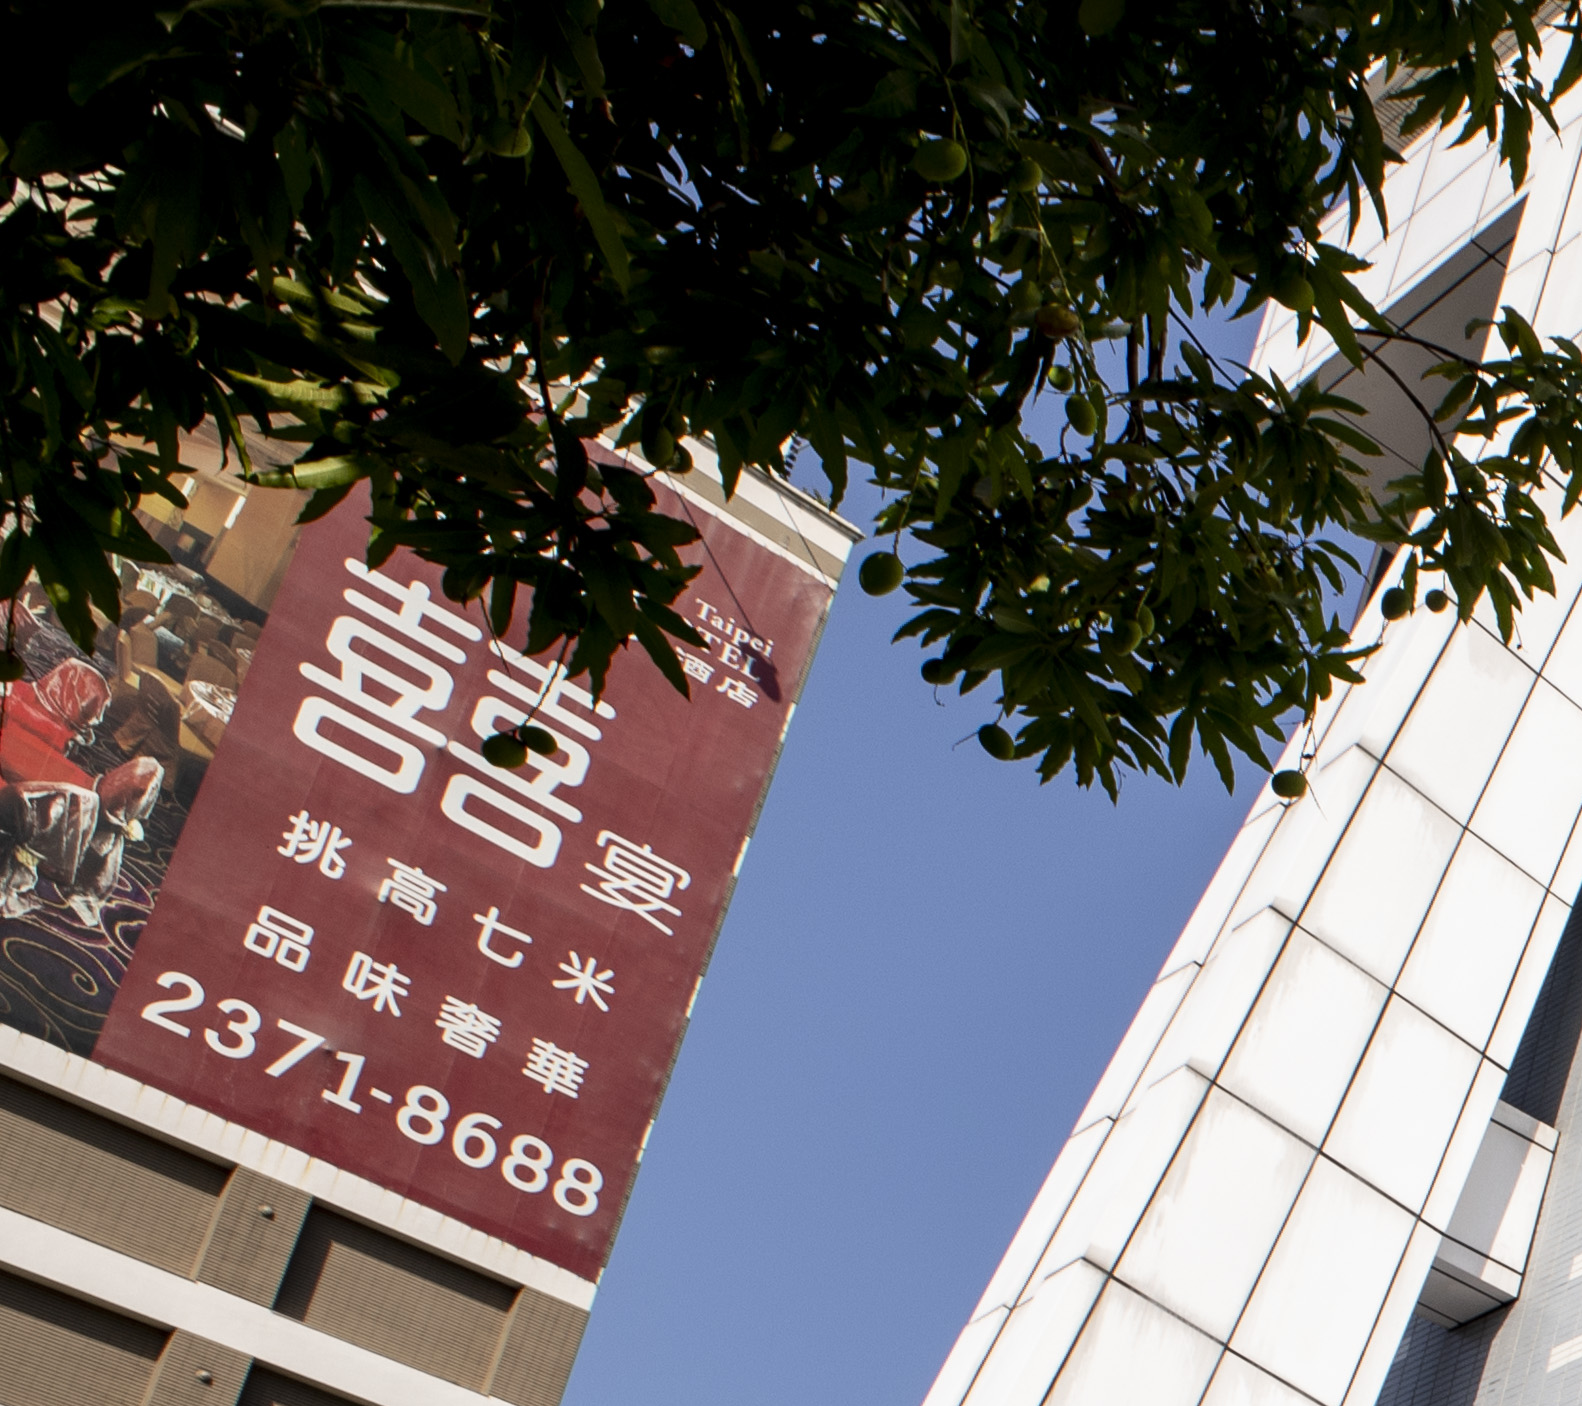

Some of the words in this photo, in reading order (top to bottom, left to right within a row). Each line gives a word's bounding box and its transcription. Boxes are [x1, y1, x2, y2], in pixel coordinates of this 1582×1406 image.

[683, 617, 760, 682] TEL
[695, 598, 775, 658] Taipei
[244, 905, 590, 1099] 品味奢華
[278, 810, 615, 1012] 挑高七米
[140, 971, 603, 1217] 2371-8688
